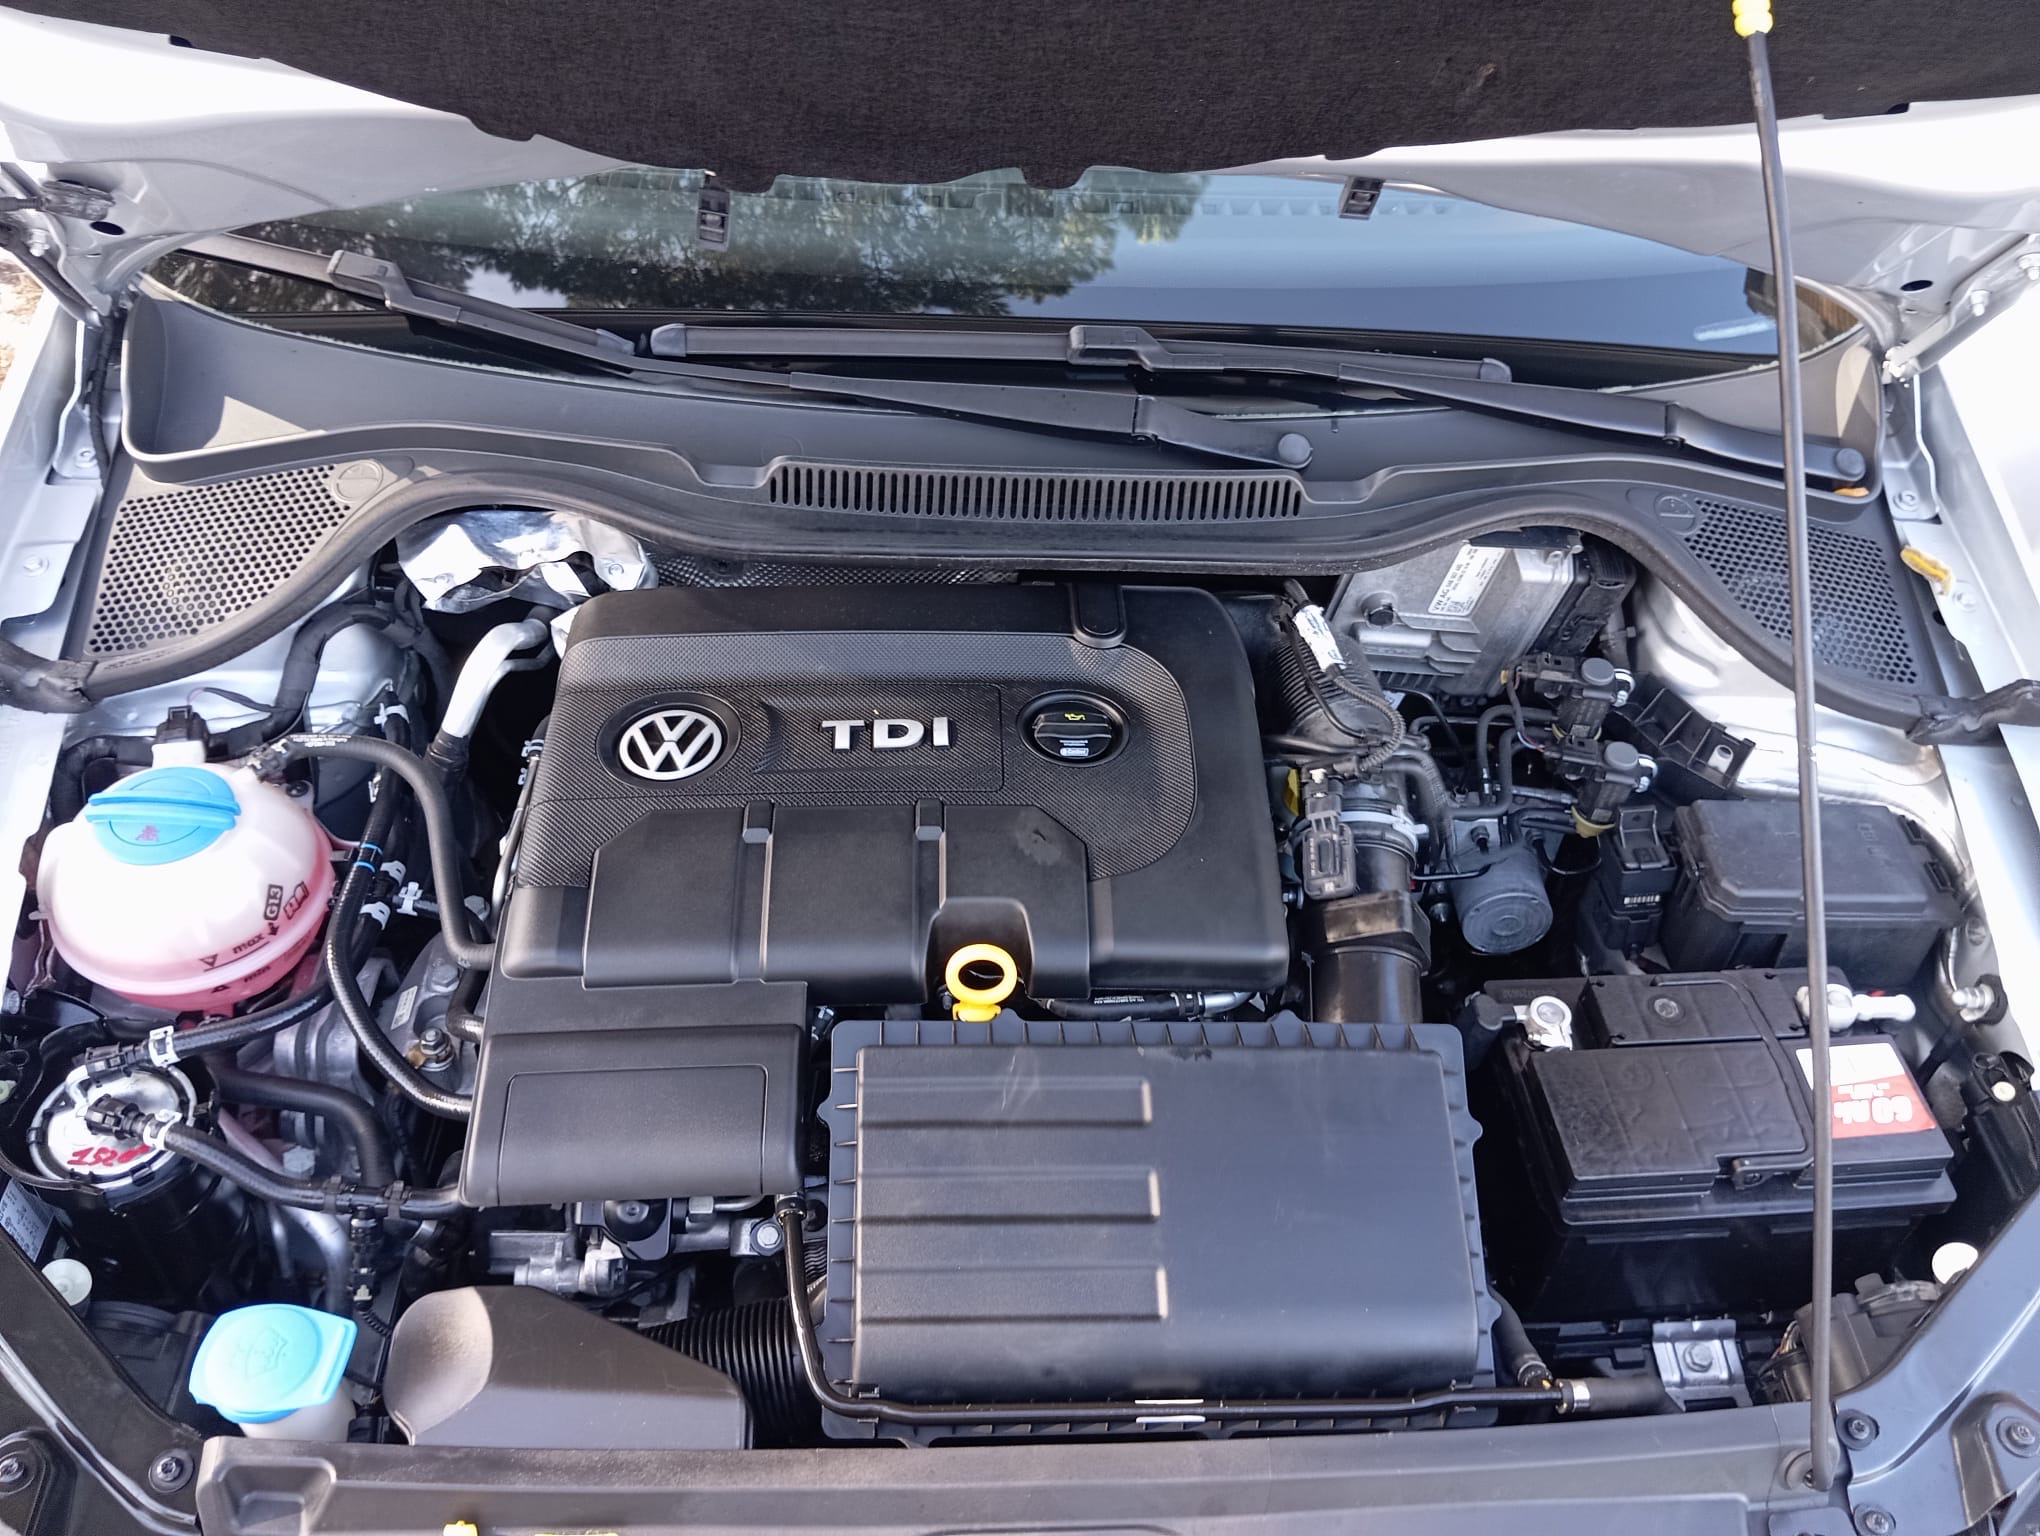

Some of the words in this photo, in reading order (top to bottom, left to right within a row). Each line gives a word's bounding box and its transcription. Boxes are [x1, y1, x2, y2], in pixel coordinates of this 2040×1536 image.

[619, 709, 722, 781] VW
[821, 716, 950, 750] TDI
[265, 887, 282, 917] G13
[232, 934, 264, 953] max
